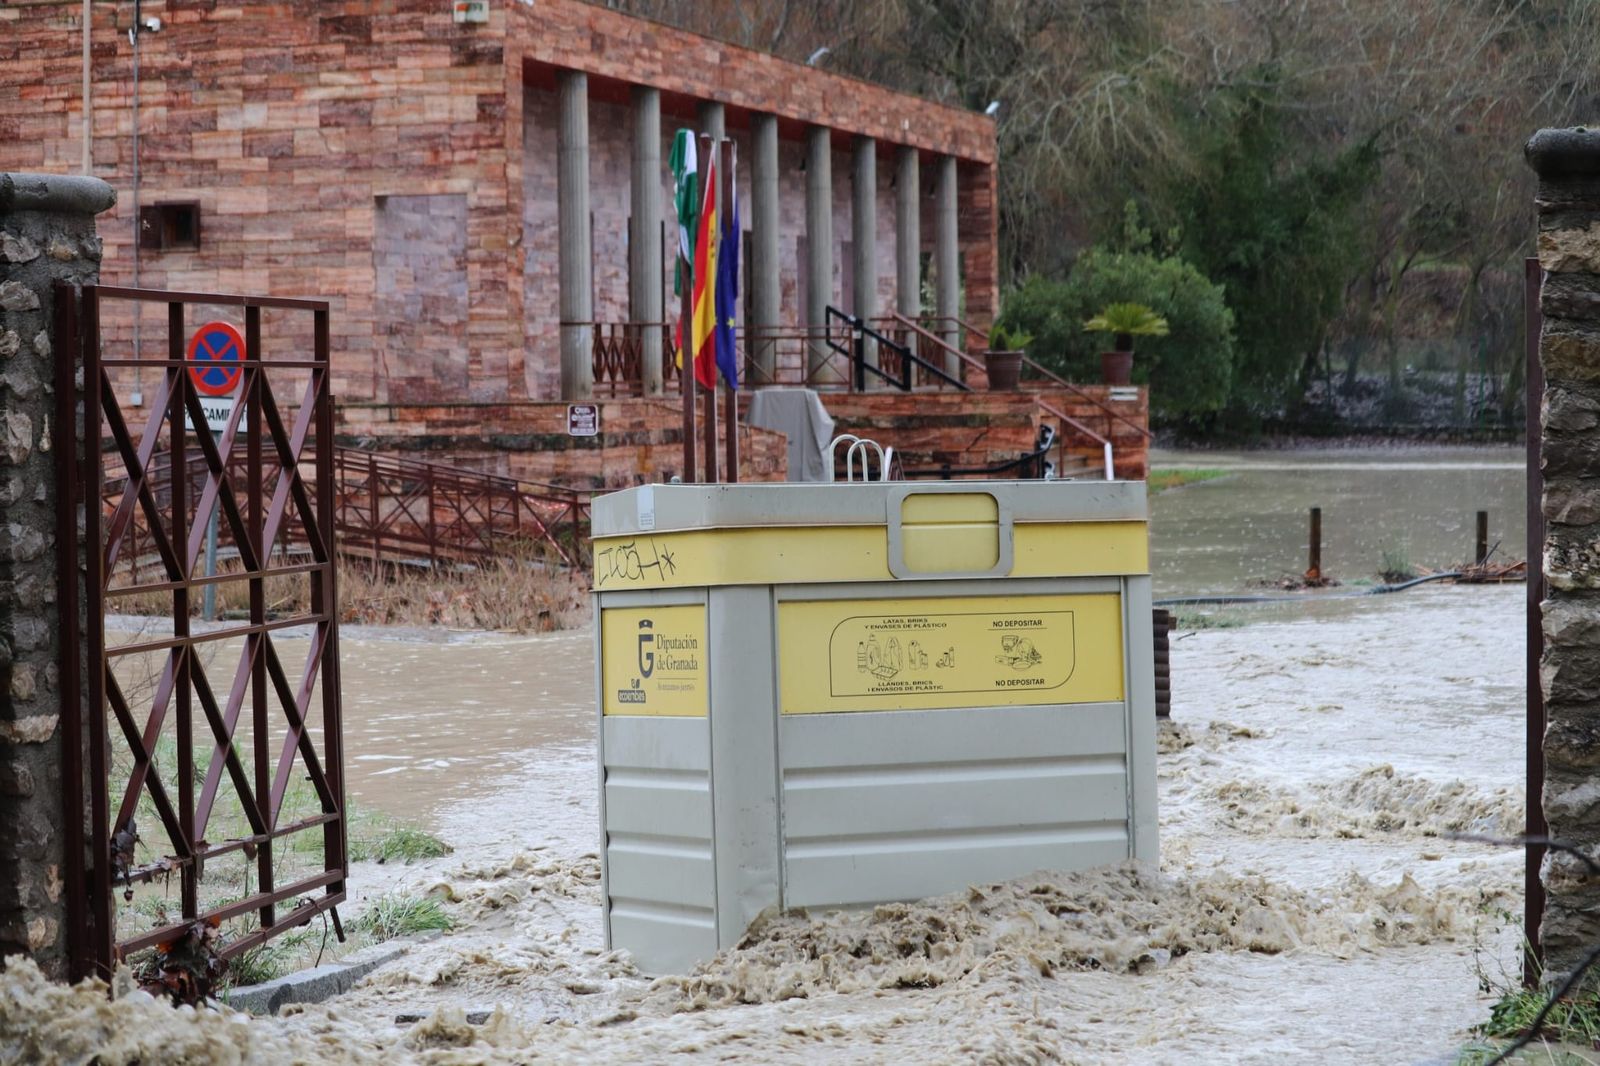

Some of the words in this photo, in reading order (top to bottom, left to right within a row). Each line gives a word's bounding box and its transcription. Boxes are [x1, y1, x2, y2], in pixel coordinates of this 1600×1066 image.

[656, 633, 698, 653] Diputación
[656, 655, 666, 670] de
[666, 654, 698, 670] Granada
